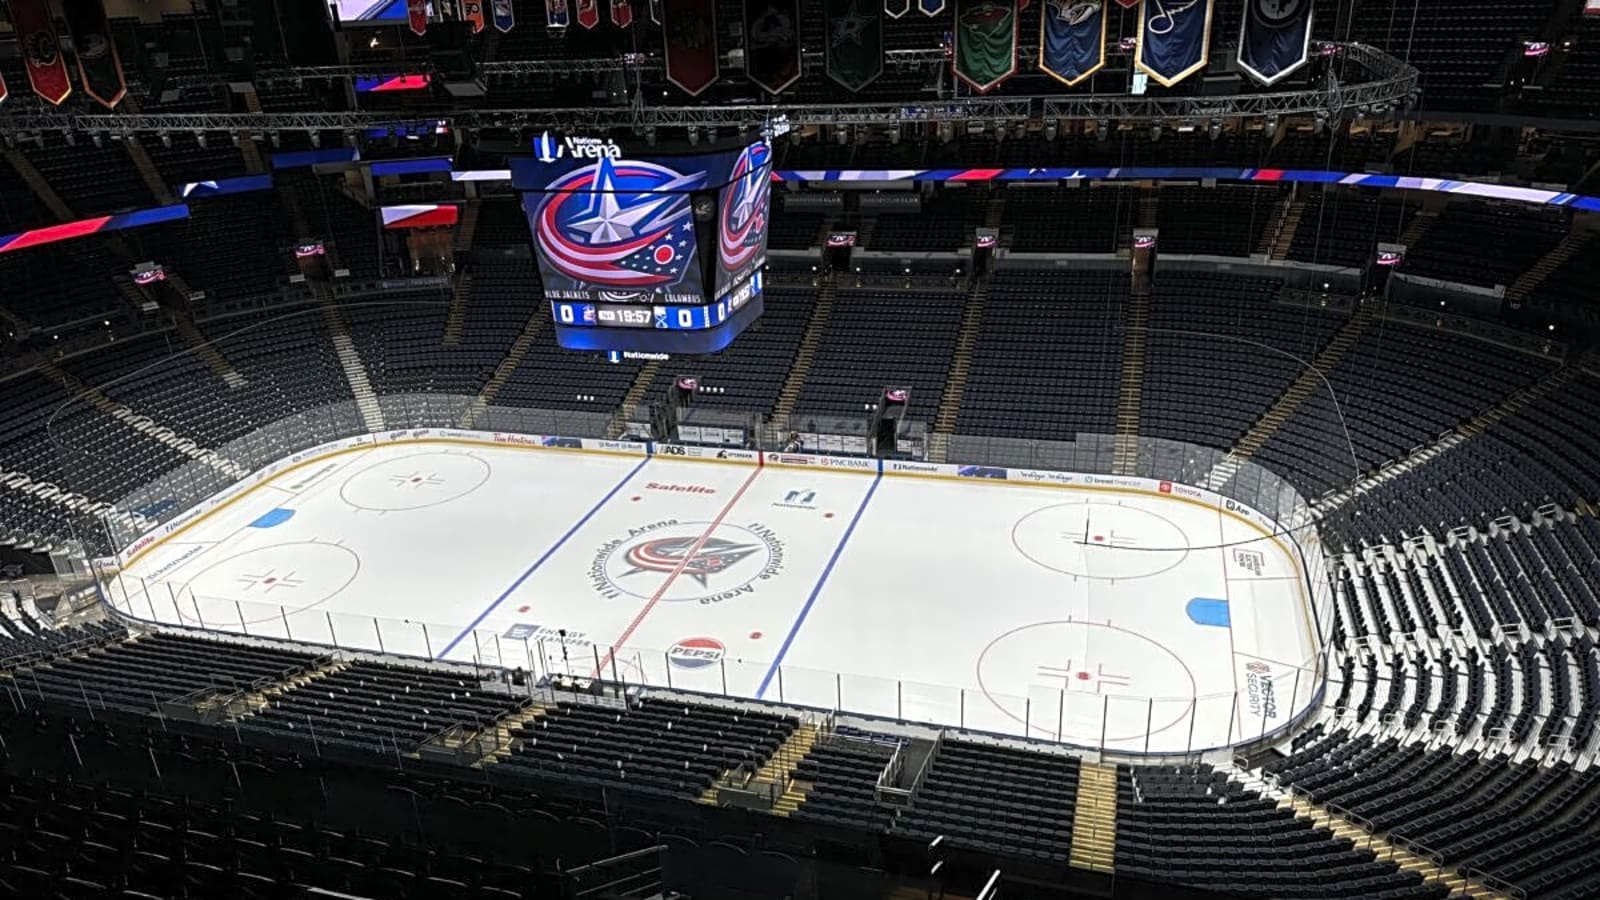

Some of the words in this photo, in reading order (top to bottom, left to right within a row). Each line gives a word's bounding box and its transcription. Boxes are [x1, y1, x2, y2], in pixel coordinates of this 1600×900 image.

[557, 137, 621, 158] Arena
[560, 304, 575, 323] 0
[616, 309, 652, 325] 19:57
[677, 308, 693, 328] 0
[623, 351, 670, 361] Nationwide
[665, 446, 686, 456] ADS
[645, 481, 716, 495] Safelite
[1173, 484, 1202, 498] TOYOTA
[126, 536, 155, 558] Safelite
[587, 539, 623, 592] Nationwide
[628, 519, 679, 537] Arena
[757, 529, 785, 580] Nationwide
[700, 584, 755, 605] Arena
[538, 626, 587, 639] ENEGY
[671, 646, 721, 660] PEPSI
[1246, 672, 1261, 717] SECURITY
[1259, 675, 1277, 719] VECTOR
